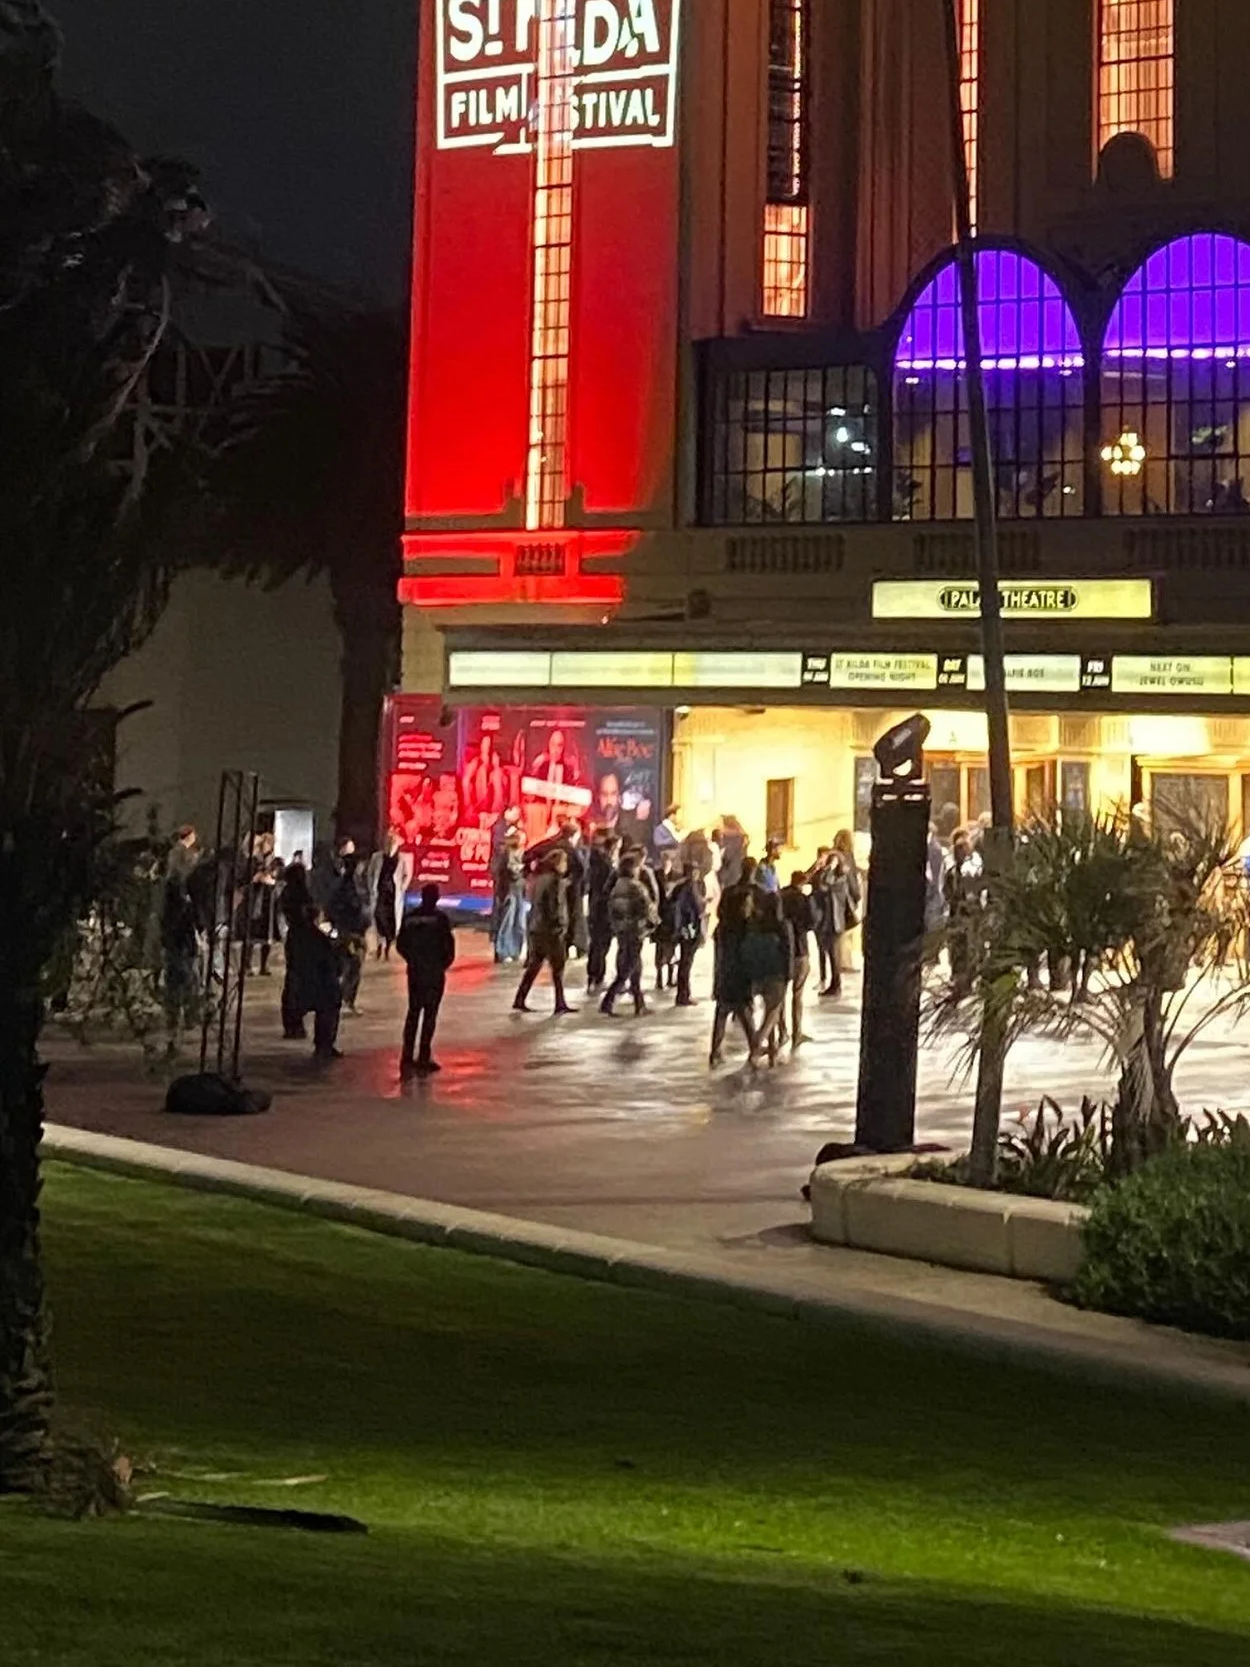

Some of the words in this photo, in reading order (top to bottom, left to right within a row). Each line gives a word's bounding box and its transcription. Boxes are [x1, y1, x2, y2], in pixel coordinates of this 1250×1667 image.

[450, 85, 518, 129] FILM
[528, 86, 661, 132] STIVAL
[1002, 590, 1066, 608] THEATRE
[846, 659, 870, 669] KILDA
[873, 659, 891, 669] FILM
[894, 659, 932, 670] FESTIVAL
[1150, 662, 1172, 672] NEXT
[1176, 662, 1191, 672] ON
[848, 672, 886, 682] OPENING
[889, 672, 917, 682] NIGHT
[1007, 668, 1025, 678] LFIE
[1139, 676, 1166, 686] JEWEL
